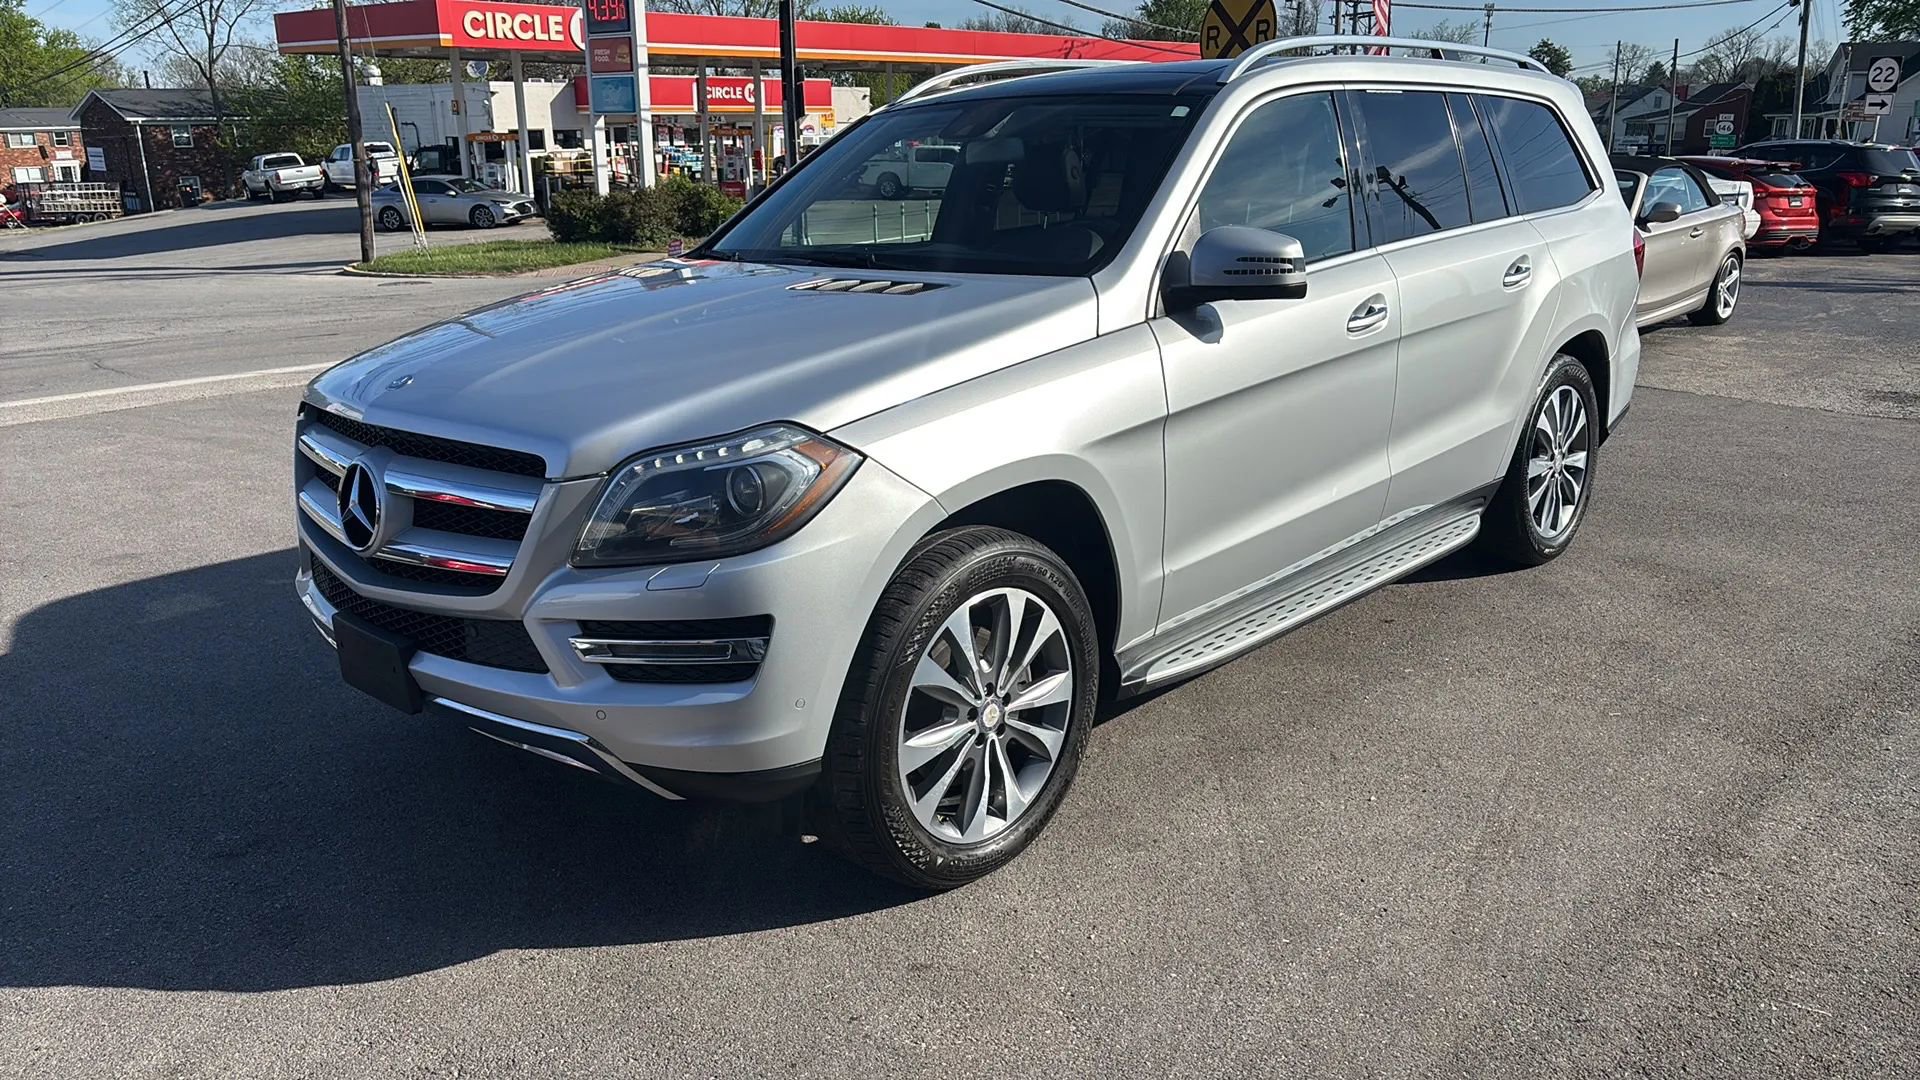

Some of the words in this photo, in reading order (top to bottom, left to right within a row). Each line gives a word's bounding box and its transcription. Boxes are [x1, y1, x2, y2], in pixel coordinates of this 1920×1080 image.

[462, 10, 565, 41] CIRCLE
[1255, 18, 1271, 44] R
[1206, 25, 1220, 50] R
[1871, 66, 1896, 83] 22
[706, 86, 743, 99] CIRCLE
[1718, 124, 1732, 132] 146
